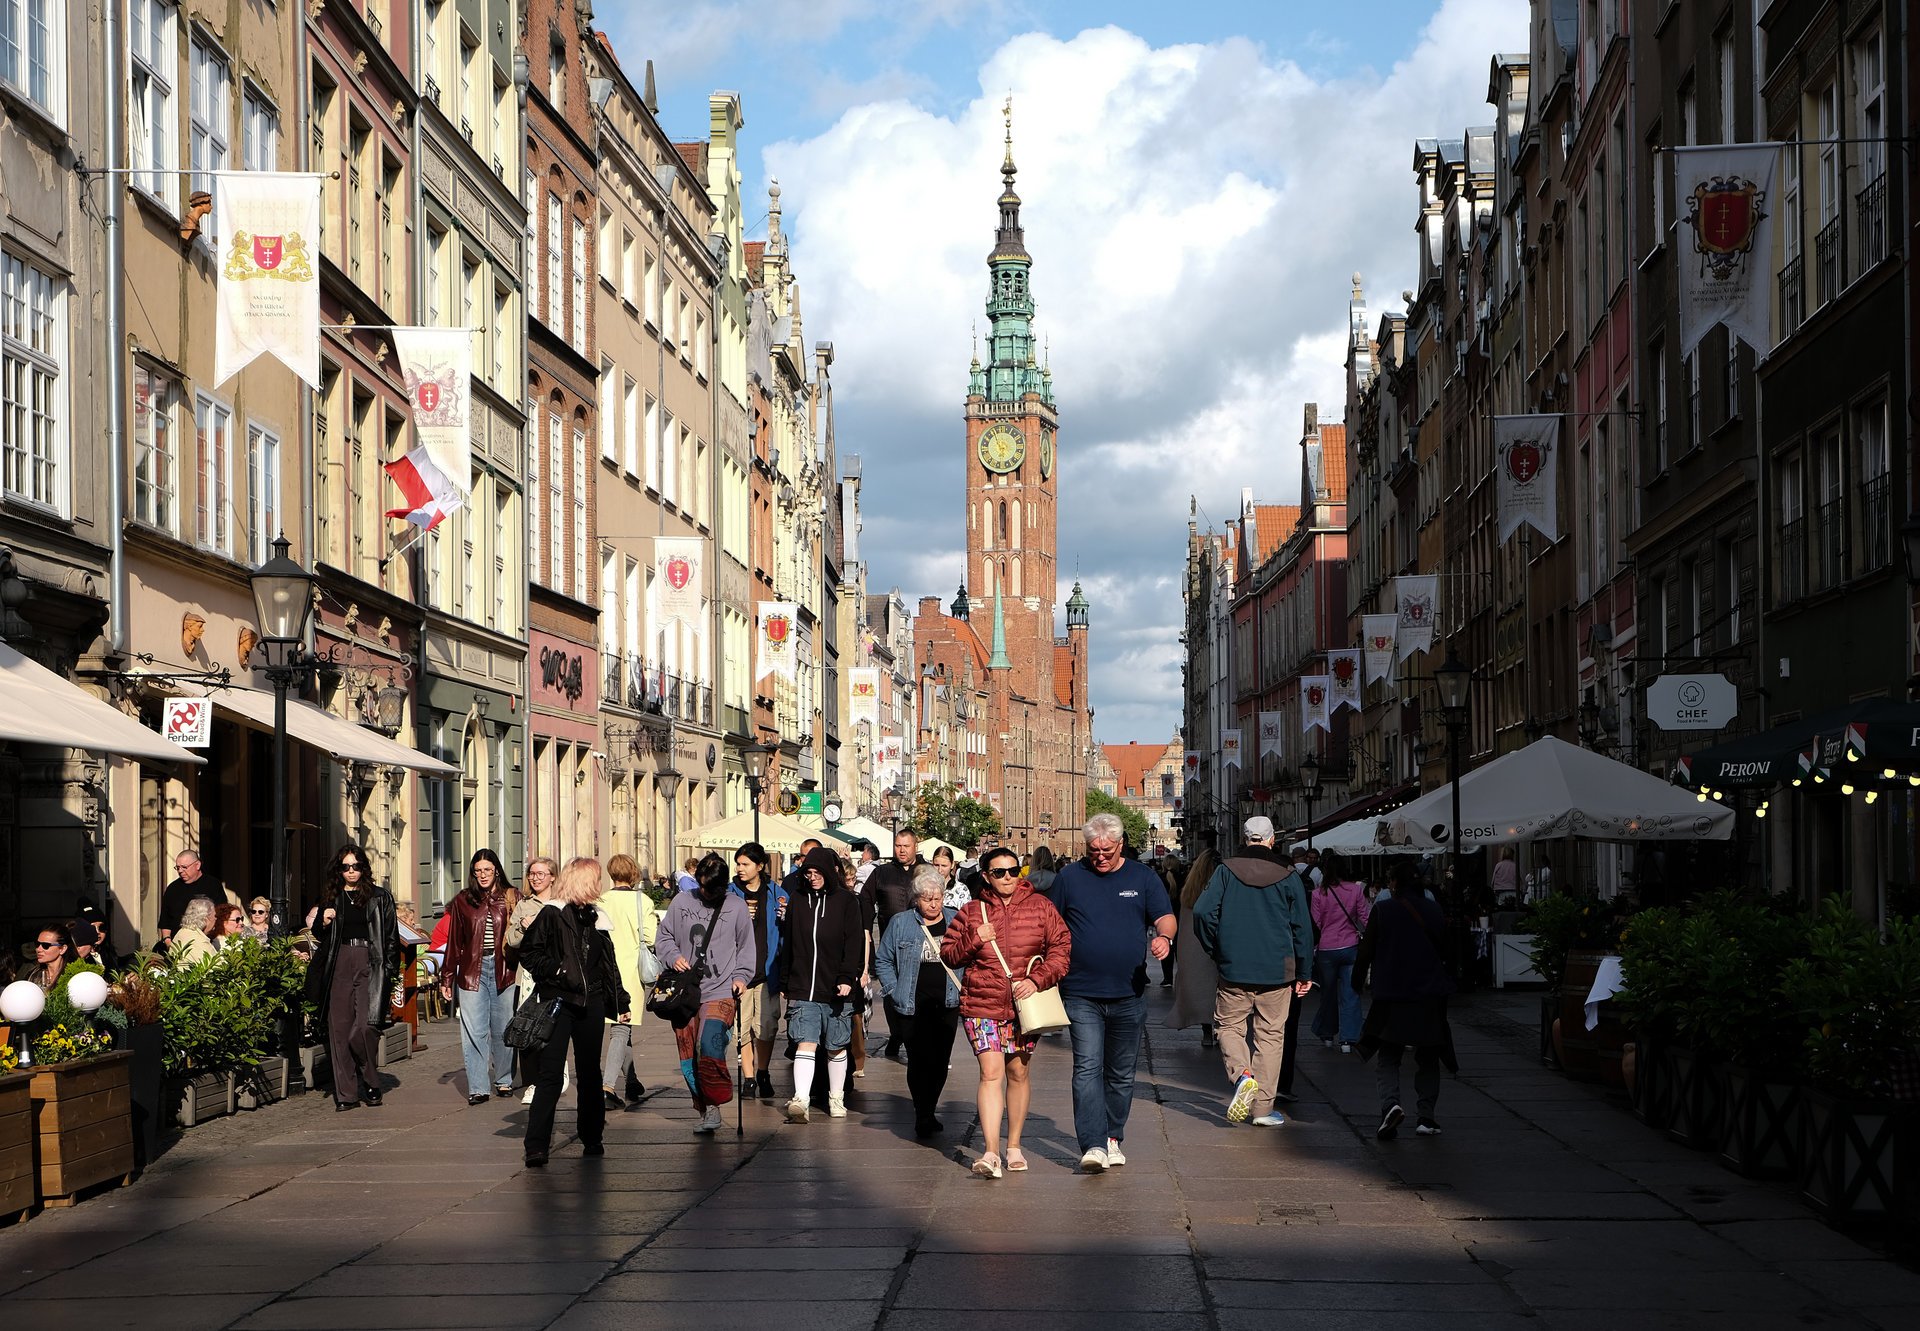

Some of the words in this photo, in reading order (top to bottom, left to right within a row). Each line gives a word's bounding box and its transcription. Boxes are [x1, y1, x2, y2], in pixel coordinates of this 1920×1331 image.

[1676, 709, 1708, 718] CHEF
[168, 733, 198, 742] Ferber
[1719, 761, 1771, 777] PERONI
[771, 841, 800, 849] GRYCA
